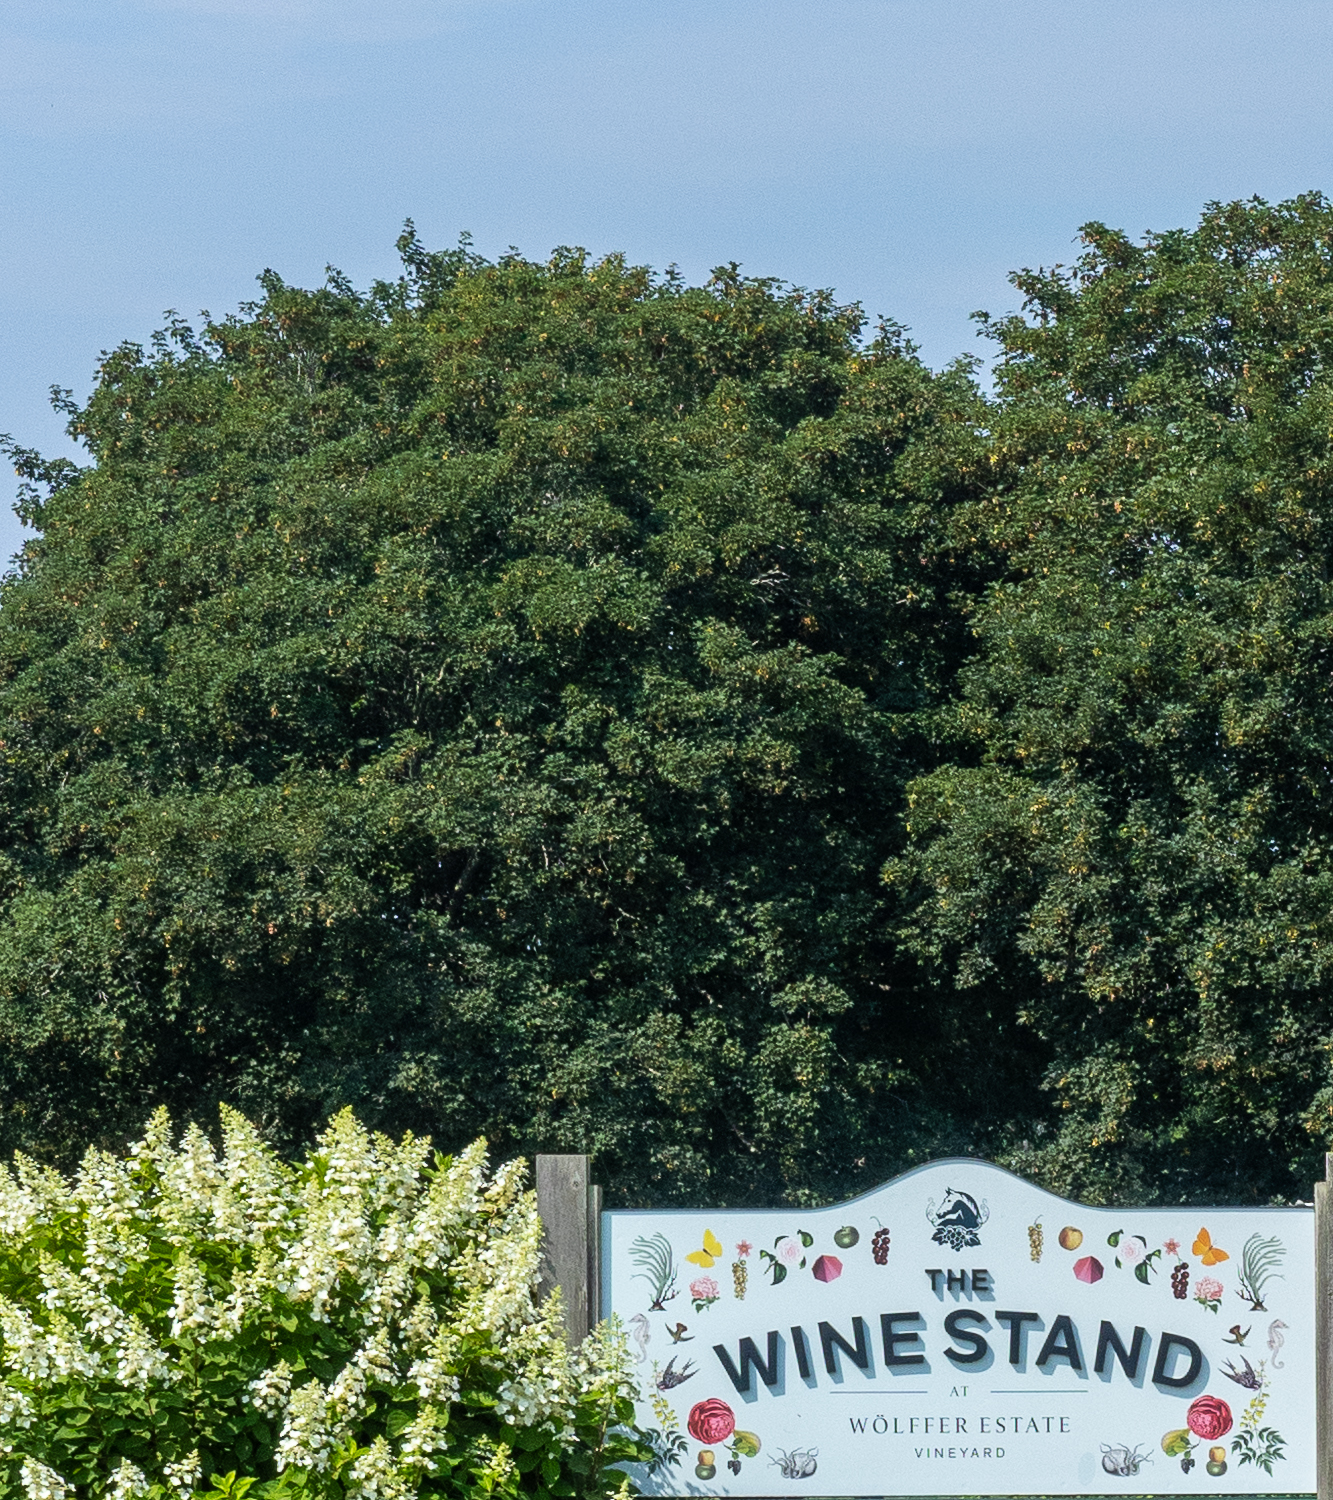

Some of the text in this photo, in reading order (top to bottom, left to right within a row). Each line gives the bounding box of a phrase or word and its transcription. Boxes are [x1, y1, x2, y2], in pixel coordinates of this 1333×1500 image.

[924, 1268, 993, 1296] THE
[948, 1384, 970, 1398] AT
[849, 1413, 1072, 1435] WÖLFFER ESTATE
[914, 1446, 1007, 1460] VINEYARD
